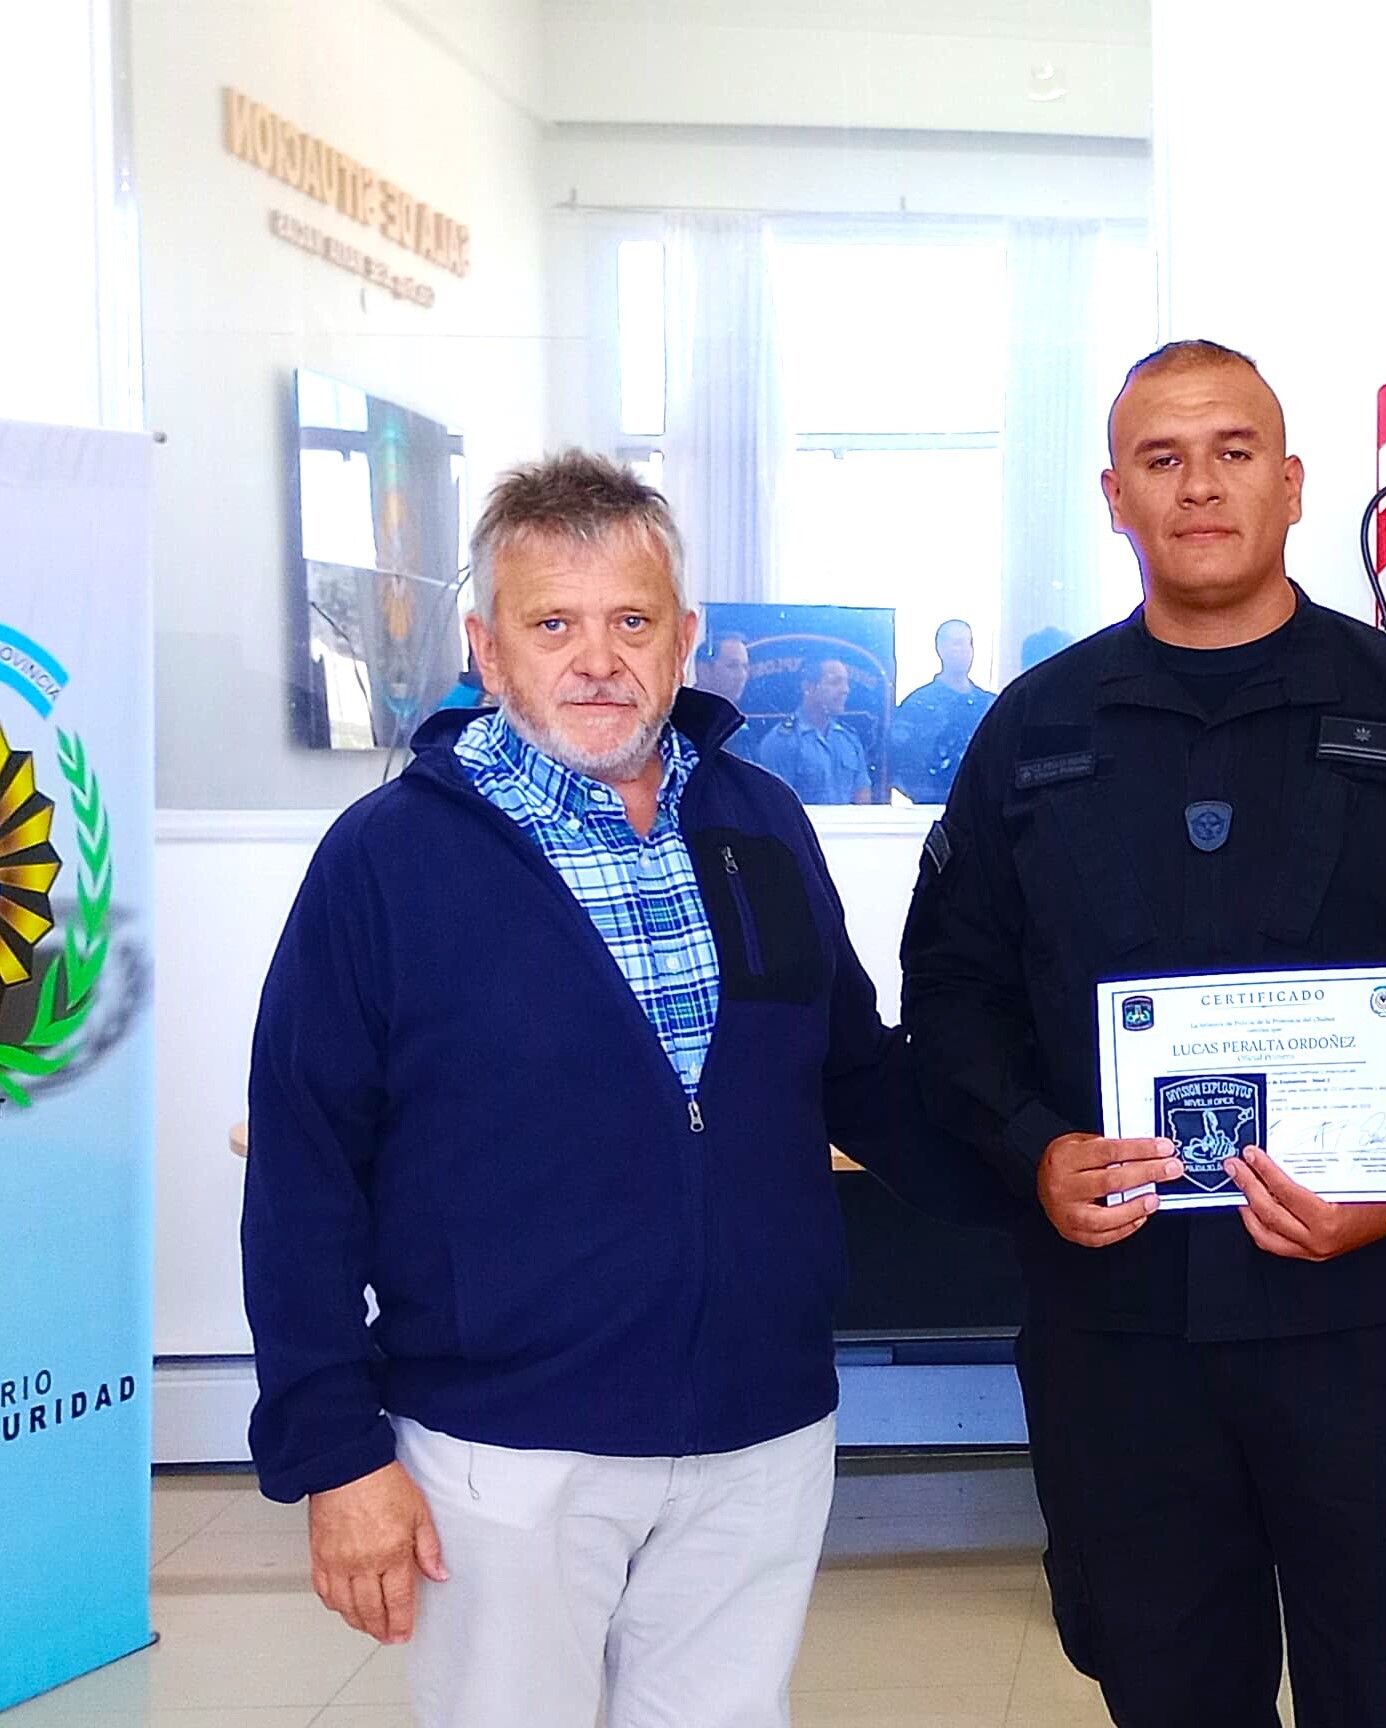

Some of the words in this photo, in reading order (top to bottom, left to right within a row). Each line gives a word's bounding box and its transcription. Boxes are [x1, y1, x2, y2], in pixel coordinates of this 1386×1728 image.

[1201, 989, 1325, 1006] CERTIFICADO
[1172, 1042, 1219, 1057] LUCAS
[1223, 1039, 1285, 1054] PERALTA
[1288, 1034, 1357, 1051] ORDOÑEZ
[1, 1369, 52, 1408] RIO
[2, 1375, 135, 1441] URIDAD
